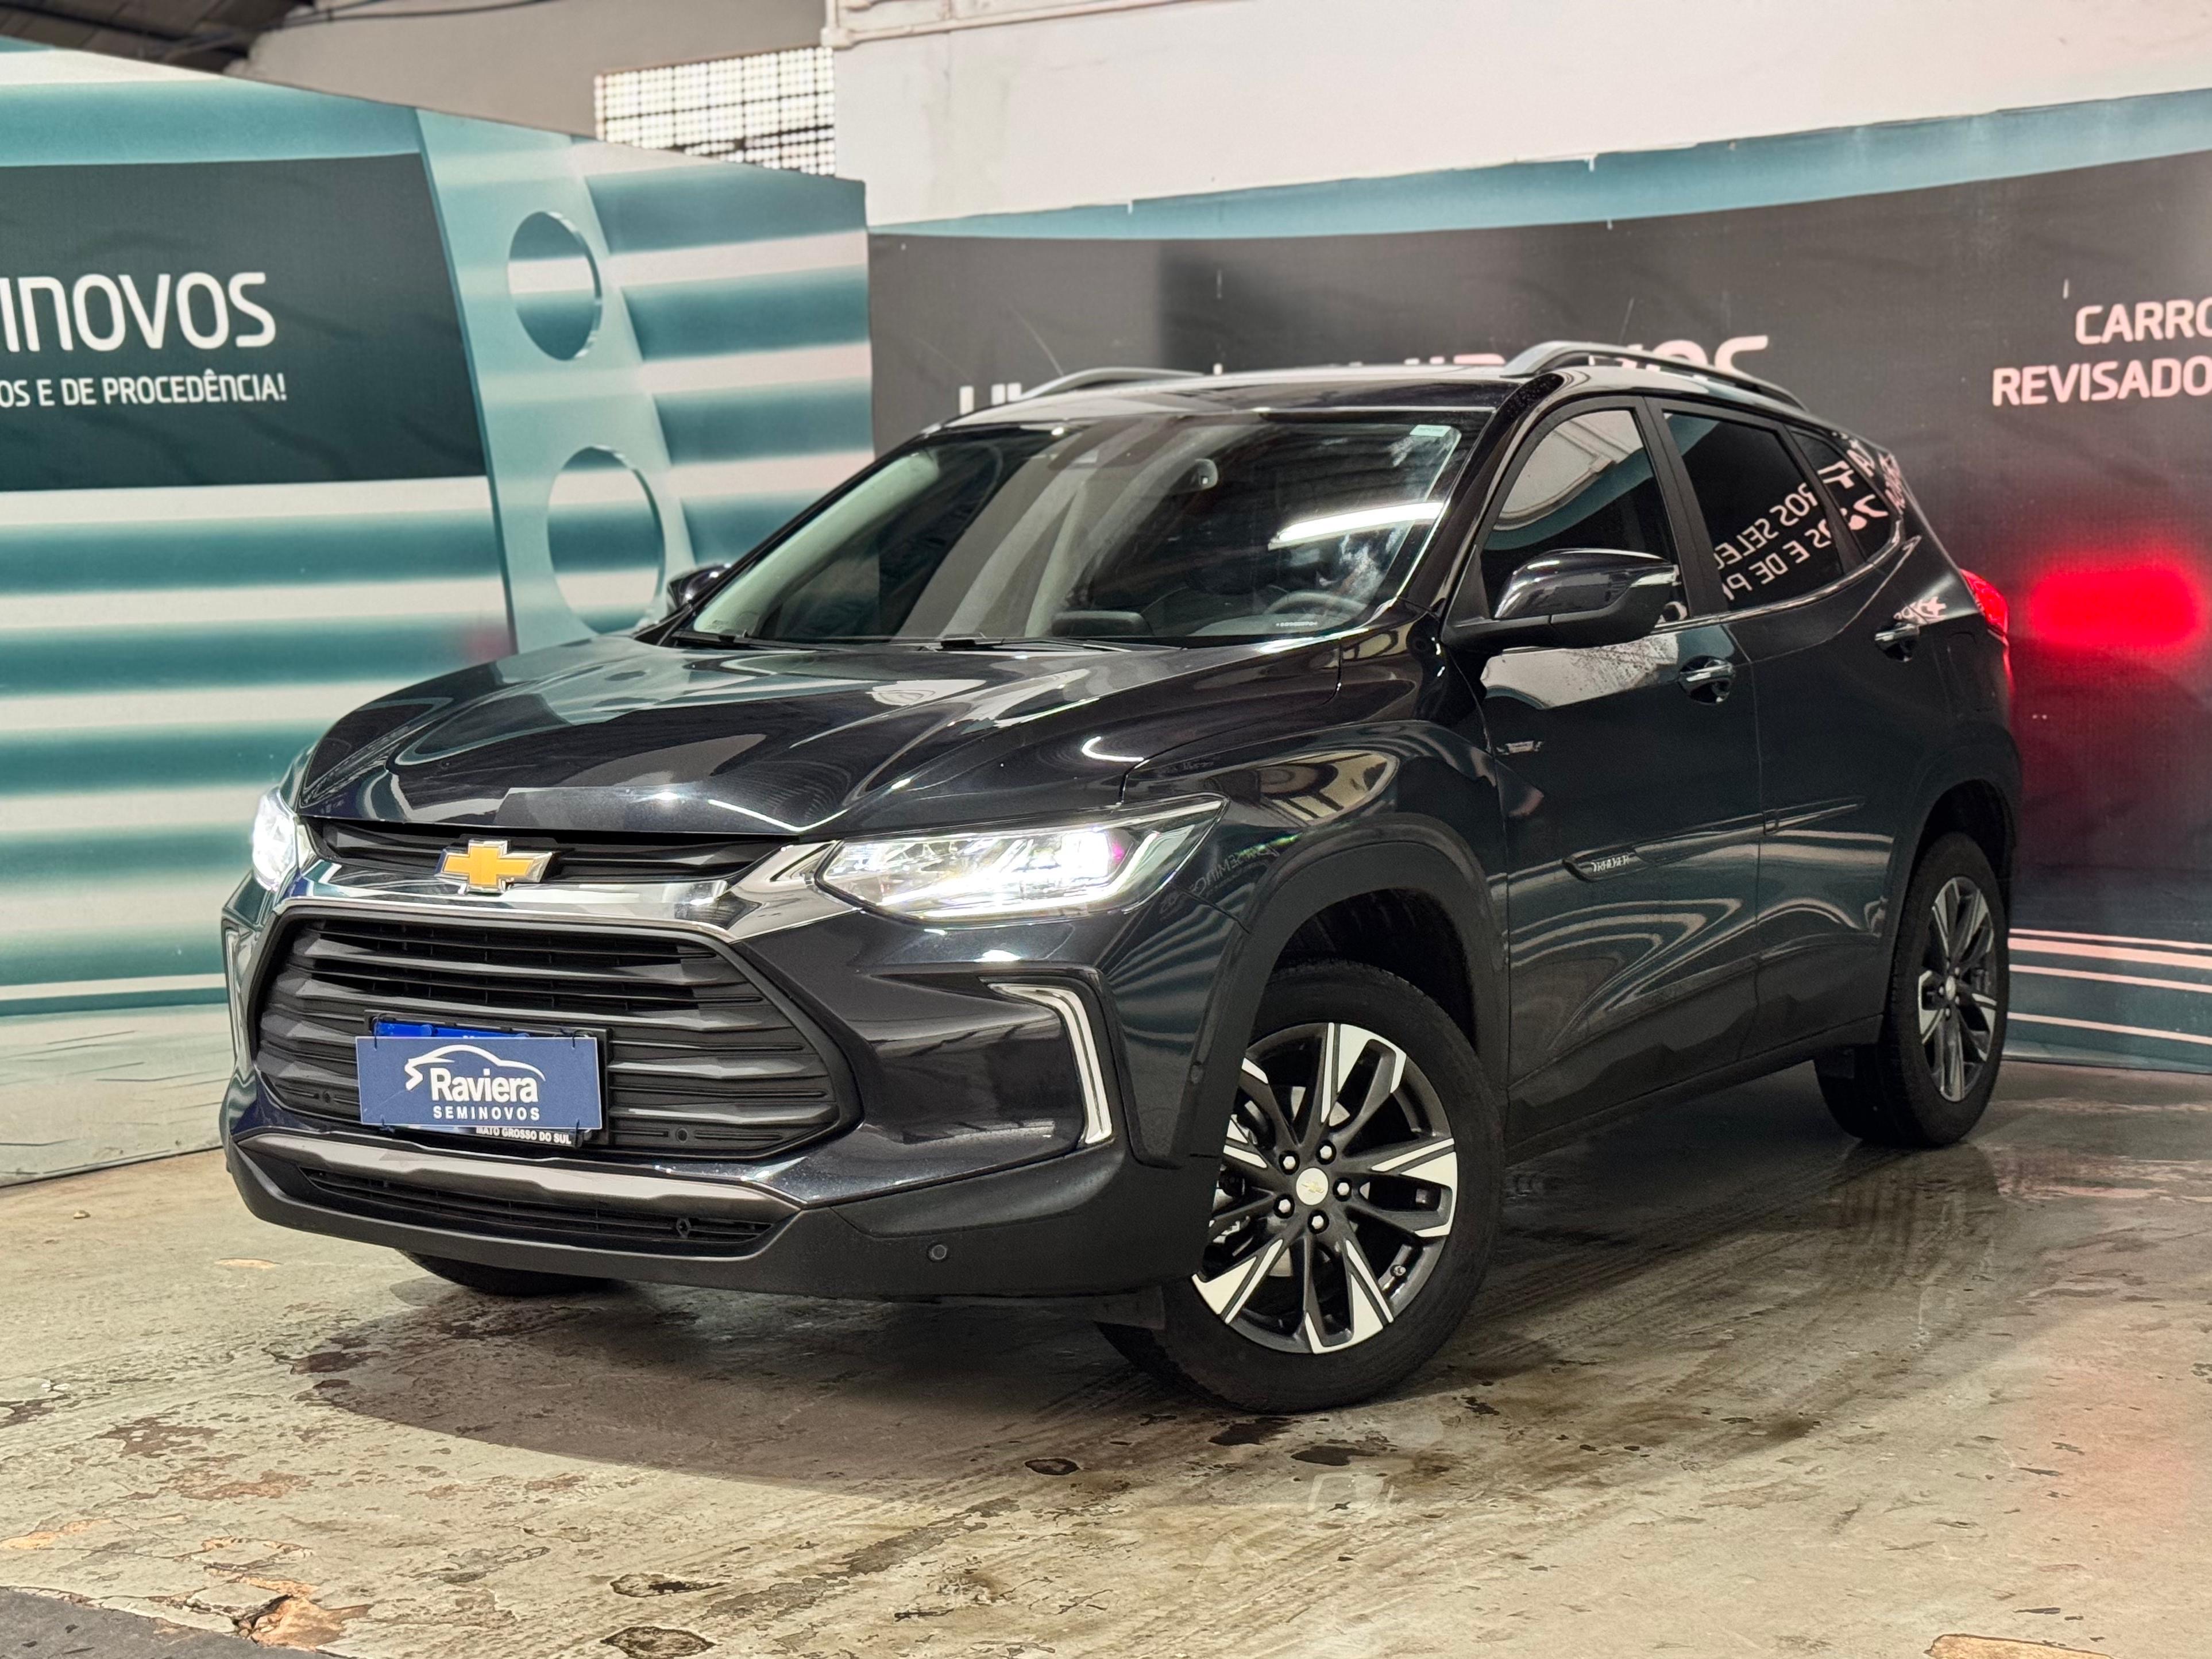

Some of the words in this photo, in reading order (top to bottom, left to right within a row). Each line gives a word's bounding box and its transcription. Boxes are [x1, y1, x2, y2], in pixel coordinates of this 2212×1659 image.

[36, 379, 56, 407] E
[61, 377, 97, 406] DE
[102, 368, 287, 404] PROCEDÊNCIA!
[1993, 355, 2212, 406] REVISADO
[430, 1067, 539, 1104] Raviera
[433, 1105, 541, 1121] SEMINOVOS
[501, 1128, 537, 1140] GROSSO
[539, 1132, 552, 1142] DO
[553, 1133, 572, 1145] SUL
